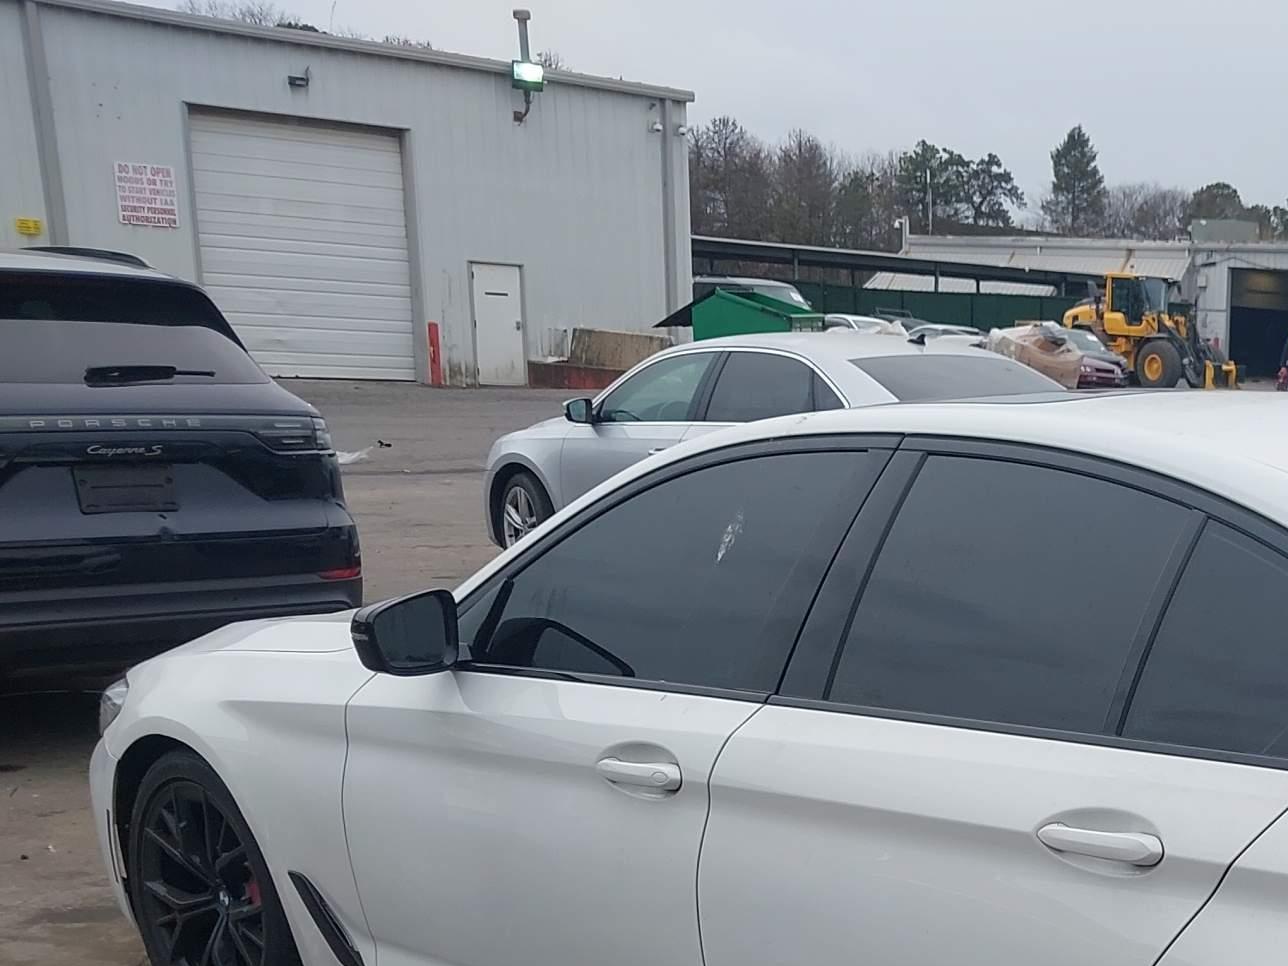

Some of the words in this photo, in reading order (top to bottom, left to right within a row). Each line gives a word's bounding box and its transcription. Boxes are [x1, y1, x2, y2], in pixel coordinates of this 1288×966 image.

[118, 163, 129, 174] DO
[132, 165, 147, 176] NOT
[151, 166, 171, 178] OPEN
[117, 175, 144, 185] HOODS
[147, 177, 157, 186] OR
[160, 179, 174, 187] TRY
[118, 185, 126, 193] TO
[128, 186, 146, 194] START
[149, 188, 175, 197] VEHICLES
[120, 195, 157, 205] WITHOUT
[121, 205, 145, 213] SECURITY
[147, 206, 176, 216] PERSONNEL
[122, 214, 176, 225] AUTHORIZATION
[29, 418, 201, 428] PORSCHE
[87, 445, 146, 457] Cayenne
[144, 445, 163, 456] S
